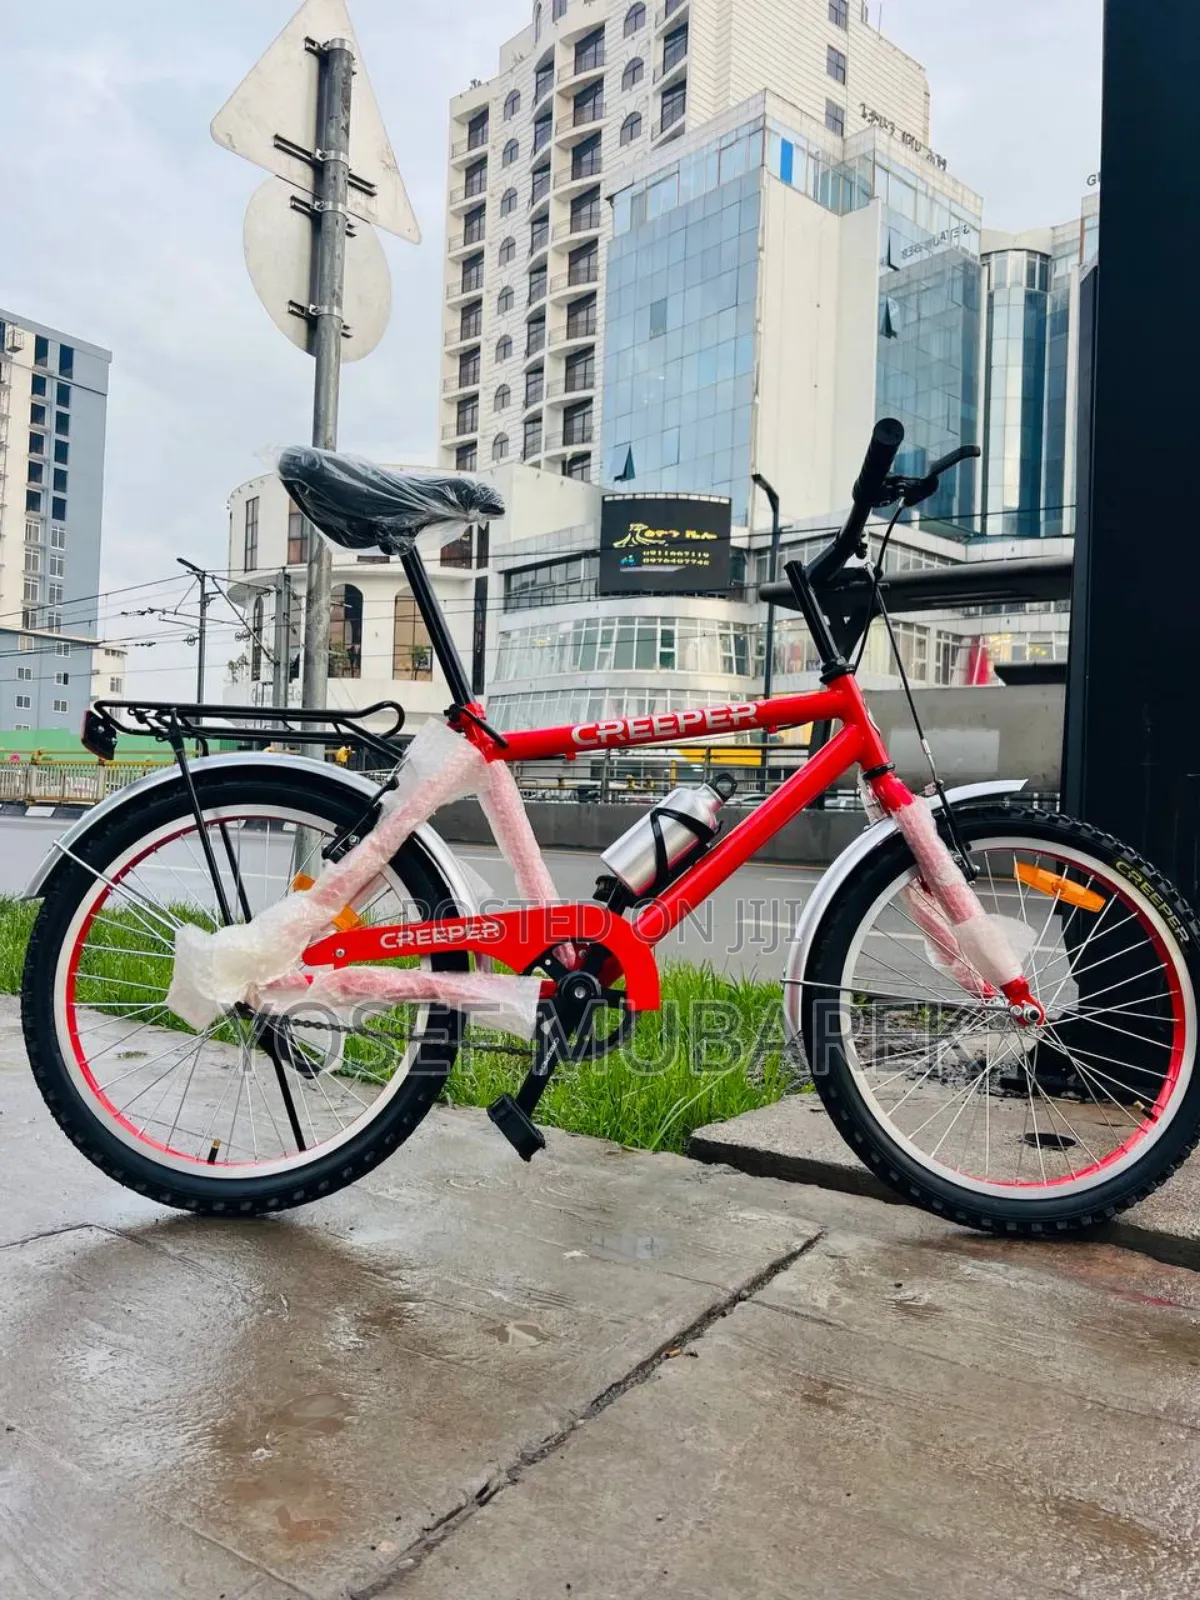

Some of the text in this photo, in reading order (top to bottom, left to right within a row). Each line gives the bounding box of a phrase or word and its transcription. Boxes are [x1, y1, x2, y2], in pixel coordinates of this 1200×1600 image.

[571, 702, 758, 746] CREEPER
[1115, 860, 1190, 943] CREEPER
[379, 921, 500, 949] CREEPER
